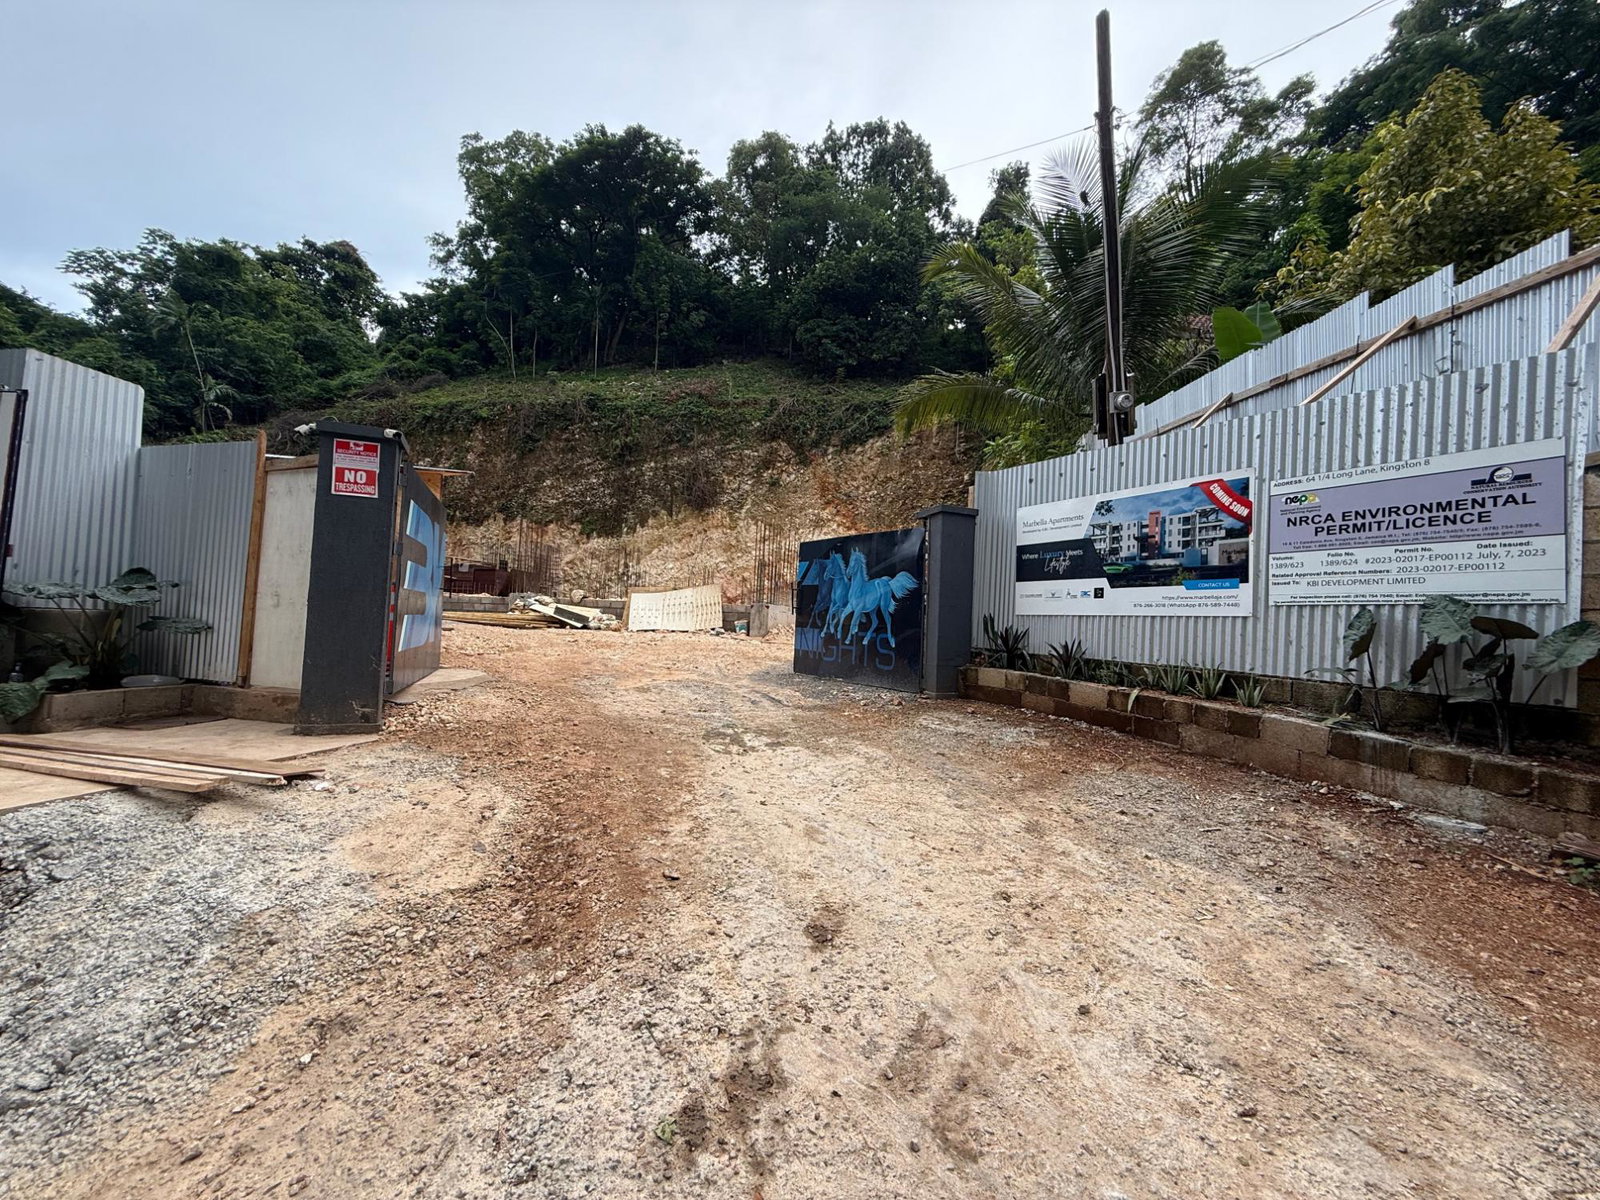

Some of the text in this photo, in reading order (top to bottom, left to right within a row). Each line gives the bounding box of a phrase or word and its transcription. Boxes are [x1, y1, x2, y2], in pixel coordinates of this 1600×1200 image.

[344, 470, 367, 484] NO
[1306, 475, 1316, 483] 64
[1318, 473, 1331, 481] 1/4
[1332, 470, 1353, 480] Long
[1355, 467, 1378, 477] Lane,
[1380, 460, 1422, 473] Kingston
[335, 482, 375, 494] TRESPASSING
[1209, 482, 1250, 518] COMING SOON
[1284, 493, 1317, 505] nepa
[1286, 492, 1536, 528] NRCA ENVIRONMENTAL
[1022, 514, 1085, 528] Marbella Apartments
[1314, 510, 1492, 537] PERMIT/LICENCE
[1499, 540, 1533, 548] Issued:
[1040, 550, 1064, 560] Luxury
[1270, 561, 1304, 570] 1389/623
[1320, 558, 1359, 567] 1389/624
[1476, 551, 1500, 561] July,
[1504, 550, 1515, 558] 7,
[1517, 548, 1547, 557] 2023
[1294, 571, 1322, 579] Approval
[1396, 562, 1505, 574] 2023-02017-EP00112
[1321, 577, 1384, 587] DEVELOPMENT
[1387, 576, 1426, 585] LIMITED
